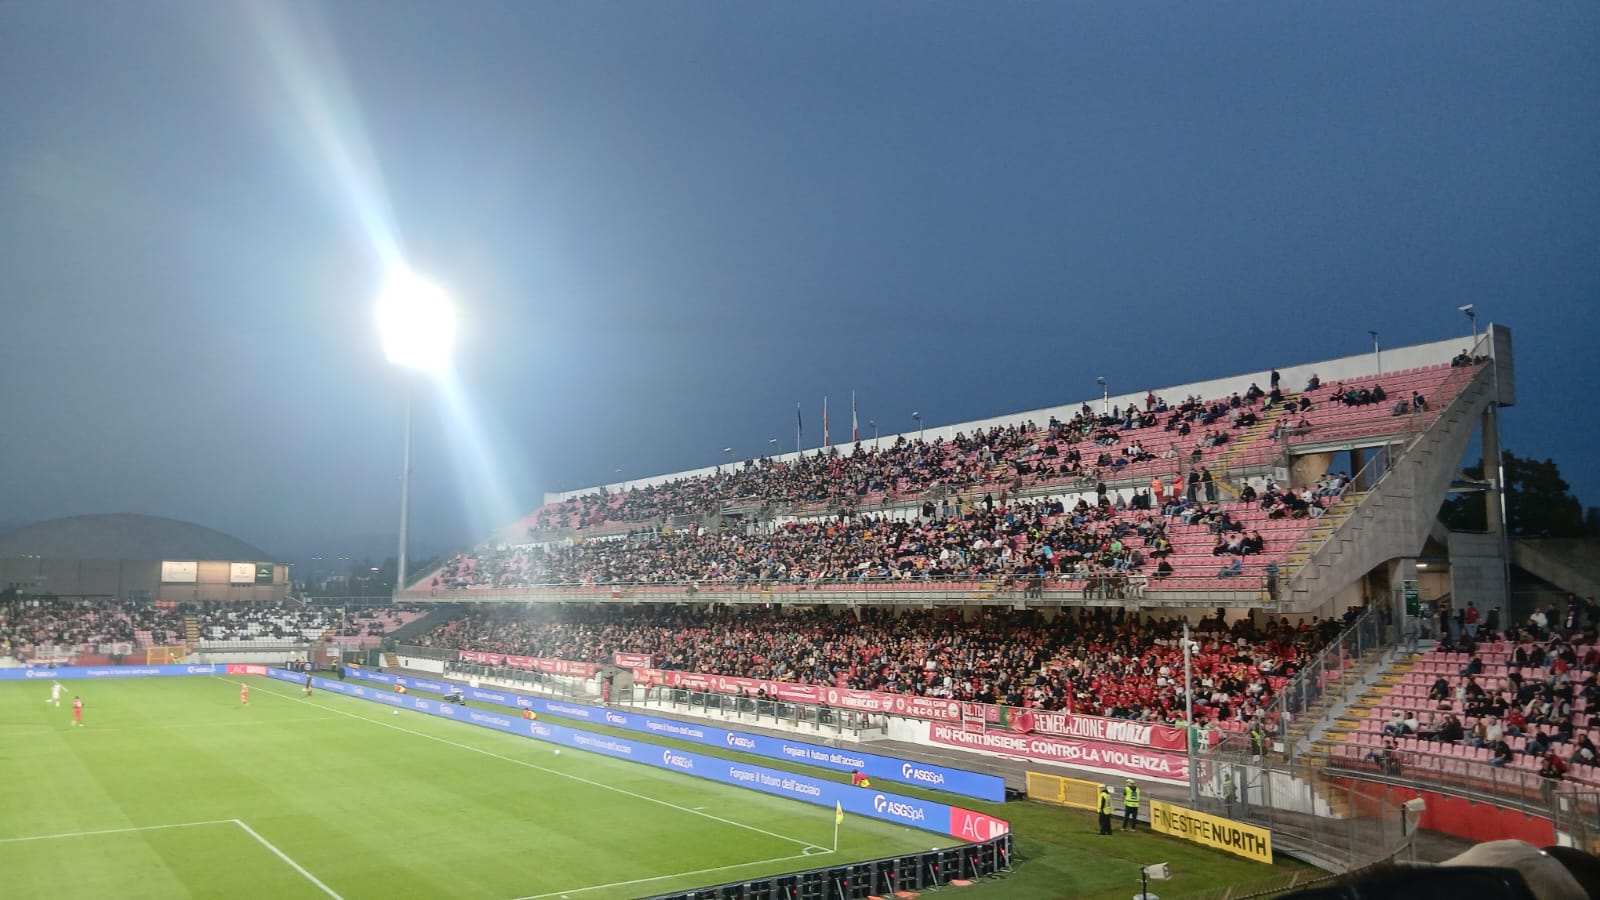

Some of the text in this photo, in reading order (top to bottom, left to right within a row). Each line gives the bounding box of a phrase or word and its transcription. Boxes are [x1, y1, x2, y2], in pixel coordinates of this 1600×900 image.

[1033, 713, 1105, 739] GENERAZIONE
[1031, 741, 1081, 759] CONTRO
[1083, 747, 1100, 762] LA
[1101, 750, 1170, 773] VIOLENZA
[913, 768, 944, 785] ASGSpA
[887, 801, 925, 821] ASGSpA
[962, 814, 985, 841] AC
[1153, 807, 1267, 857] FINESTRE NURITH
